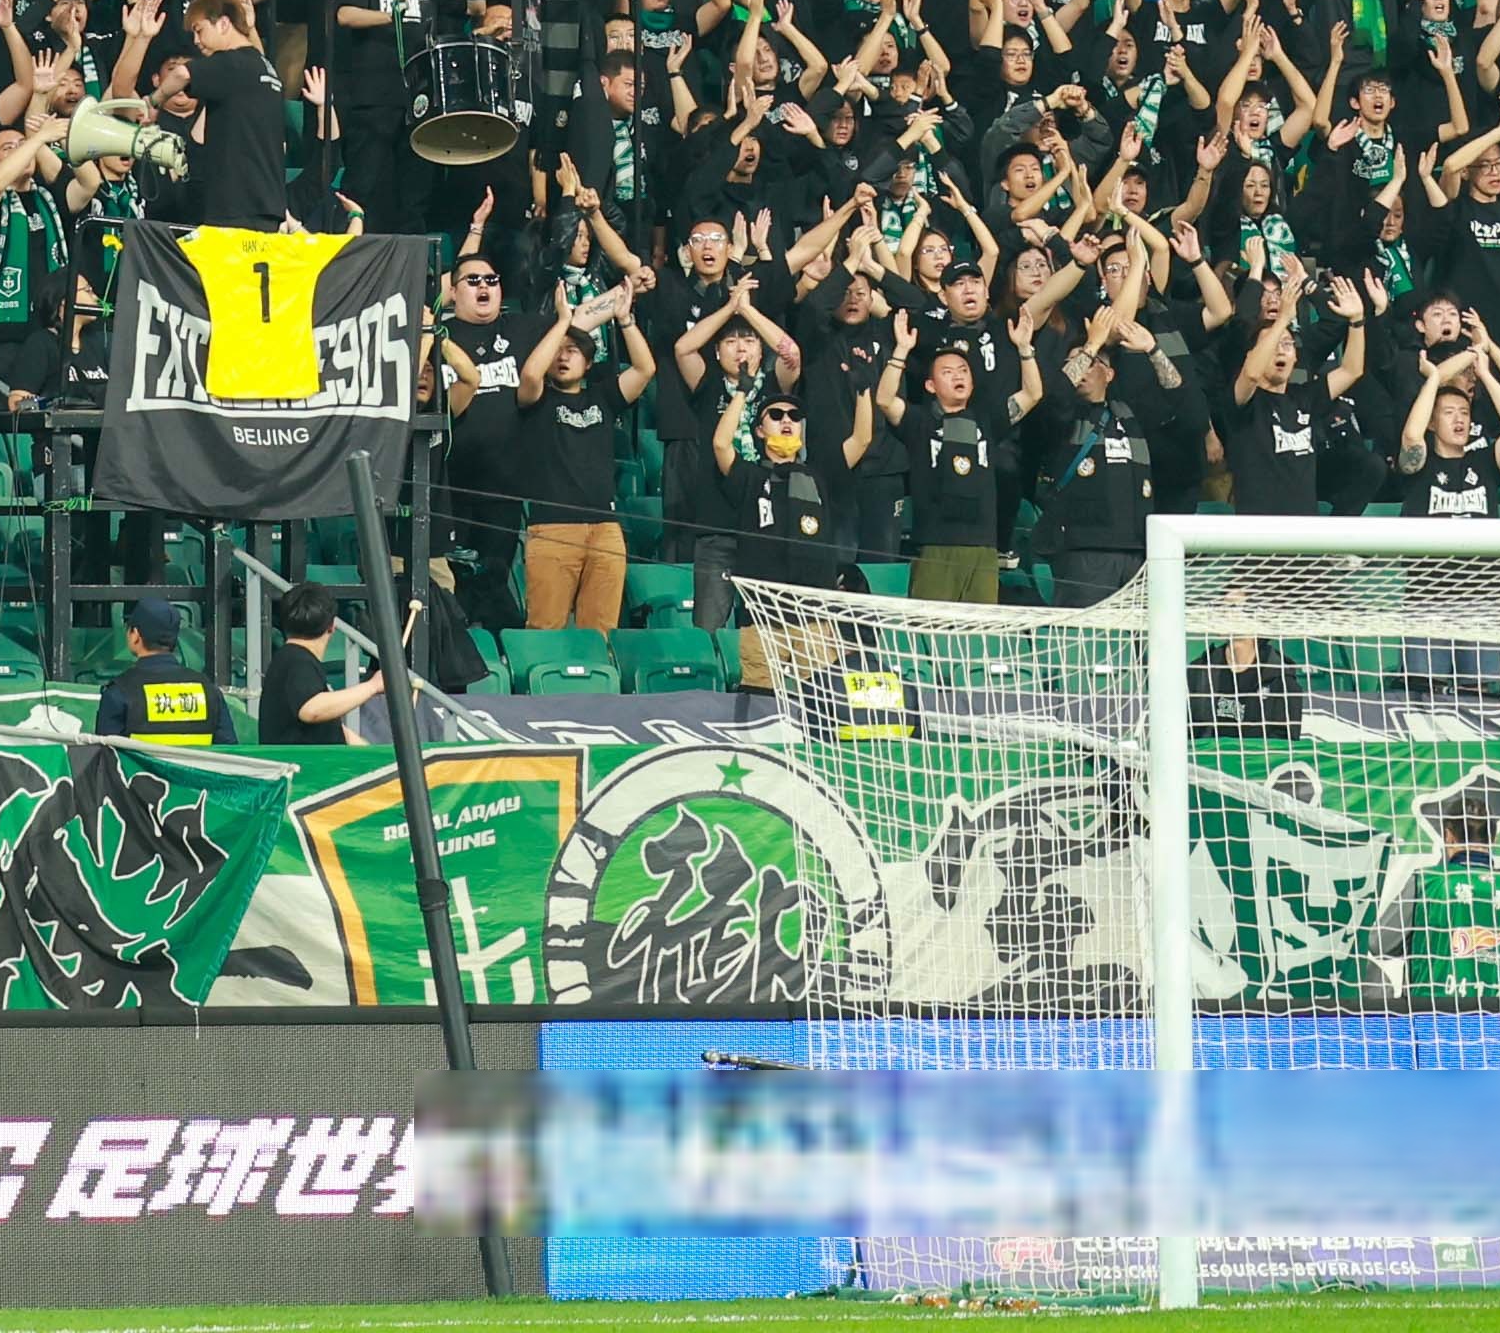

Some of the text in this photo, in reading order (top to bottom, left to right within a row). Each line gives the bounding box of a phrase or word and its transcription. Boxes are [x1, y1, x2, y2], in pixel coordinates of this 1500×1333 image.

[253, 262, 272, 324] 1
[129, 278, 411, 411] EXTE90S
[233, 425, 311, 447] BEIJING
[154, 693, 200, 715] 执勤
[382, 794, 522, 843] ROAL ARMY
[46, 1115, 415, 1223] 足球世
[1199, 1261, 1290, 1280] ESOURCES
